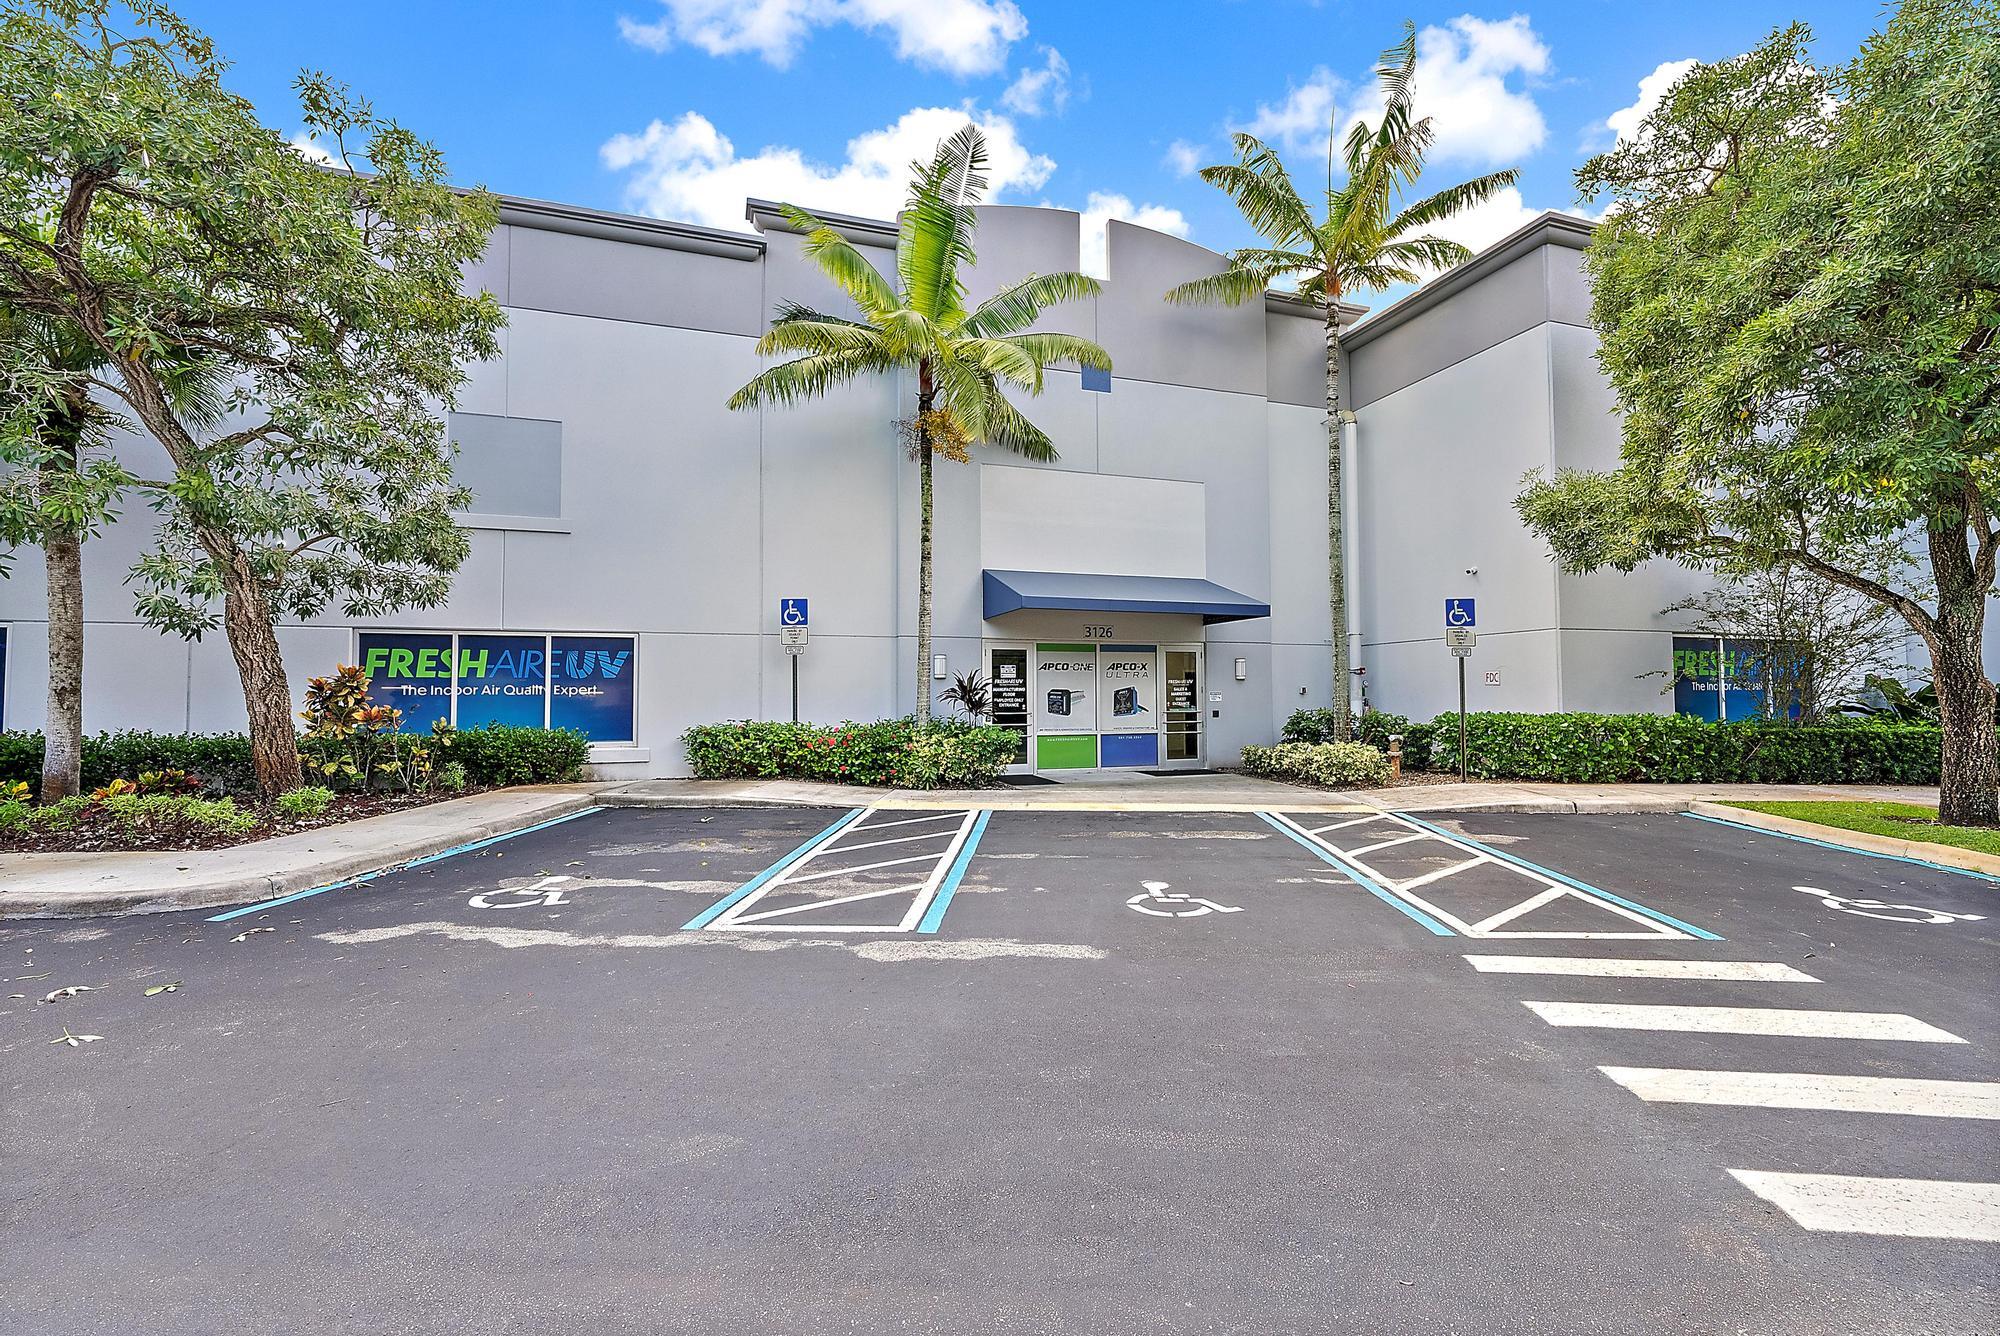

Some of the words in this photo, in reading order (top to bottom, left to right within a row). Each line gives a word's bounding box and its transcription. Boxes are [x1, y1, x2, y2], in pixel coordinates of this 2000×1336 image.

[1084, 626, 1113, 638] 3126
[565, 650, 630, 679] UV
[1105, 671, 1149, 679] ULTRA
[1485, 672, 1499, 683] FDC
[401, 685, 427, 696] The
[481, 684, 501, 696] Air
[553, 684, 598, 698] Expert
[1691, 681, 1706, 691] The
